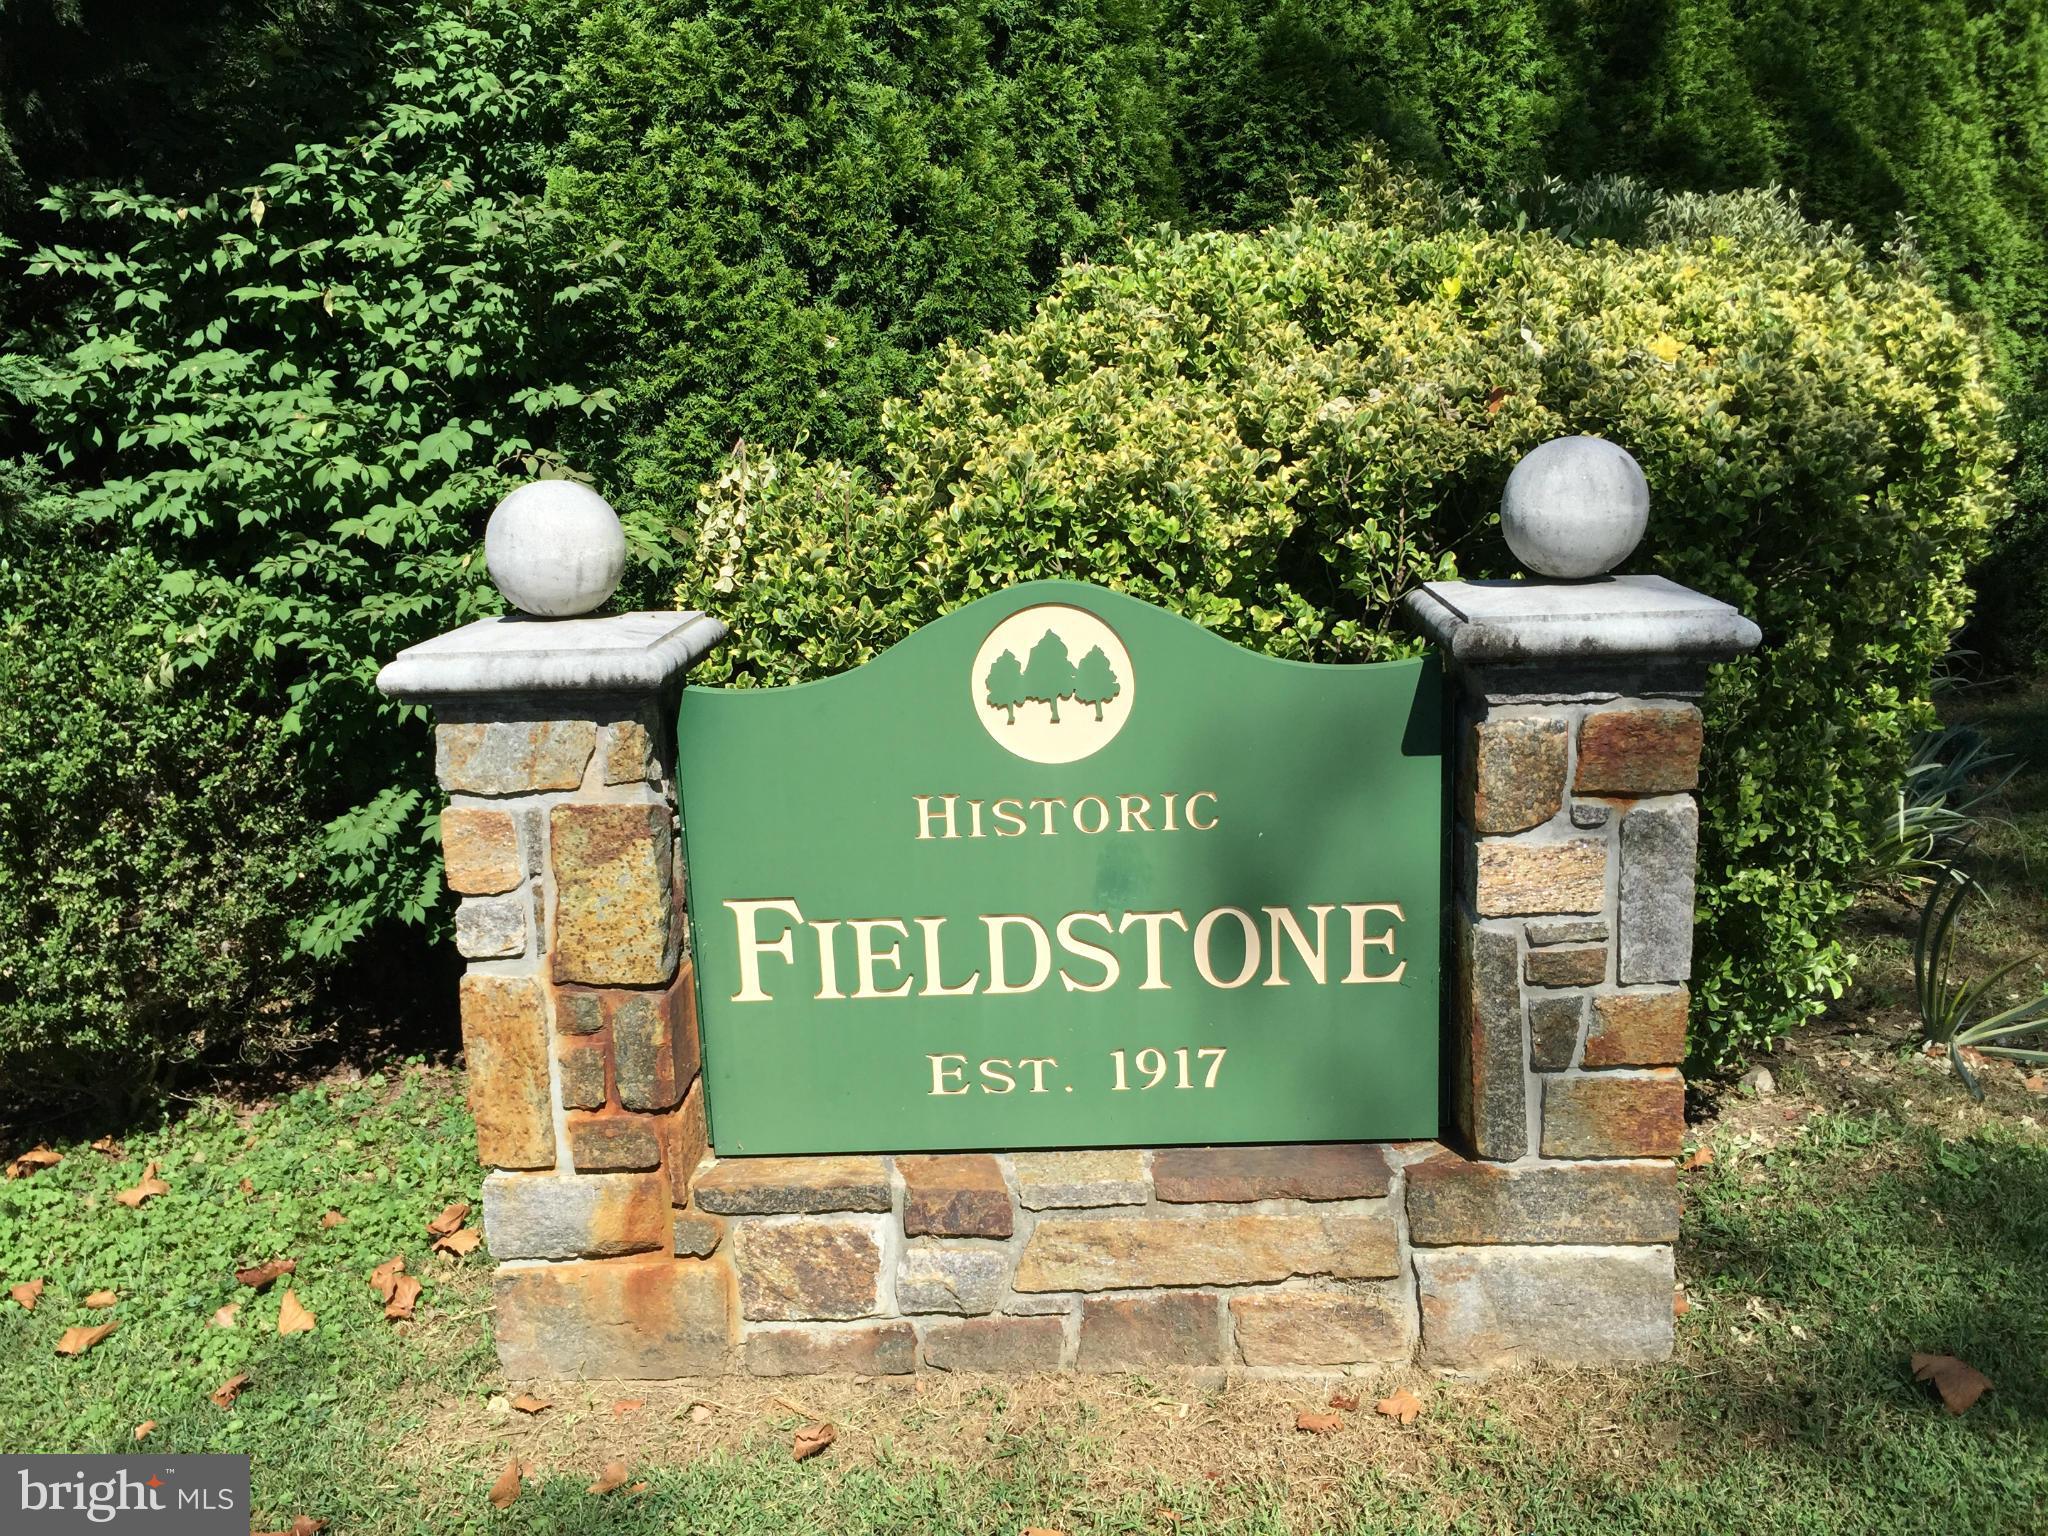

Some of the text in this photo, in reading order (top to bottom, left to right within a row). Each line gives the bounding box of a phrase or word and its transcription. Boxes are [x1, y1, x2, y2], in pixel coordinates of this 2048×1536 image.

[912, 791, 1220, 841] HISTORIC
[722, 899, 1407, 1004] FIELDSTONE
[926, 1046, 1228, 1097] EST. 1917
